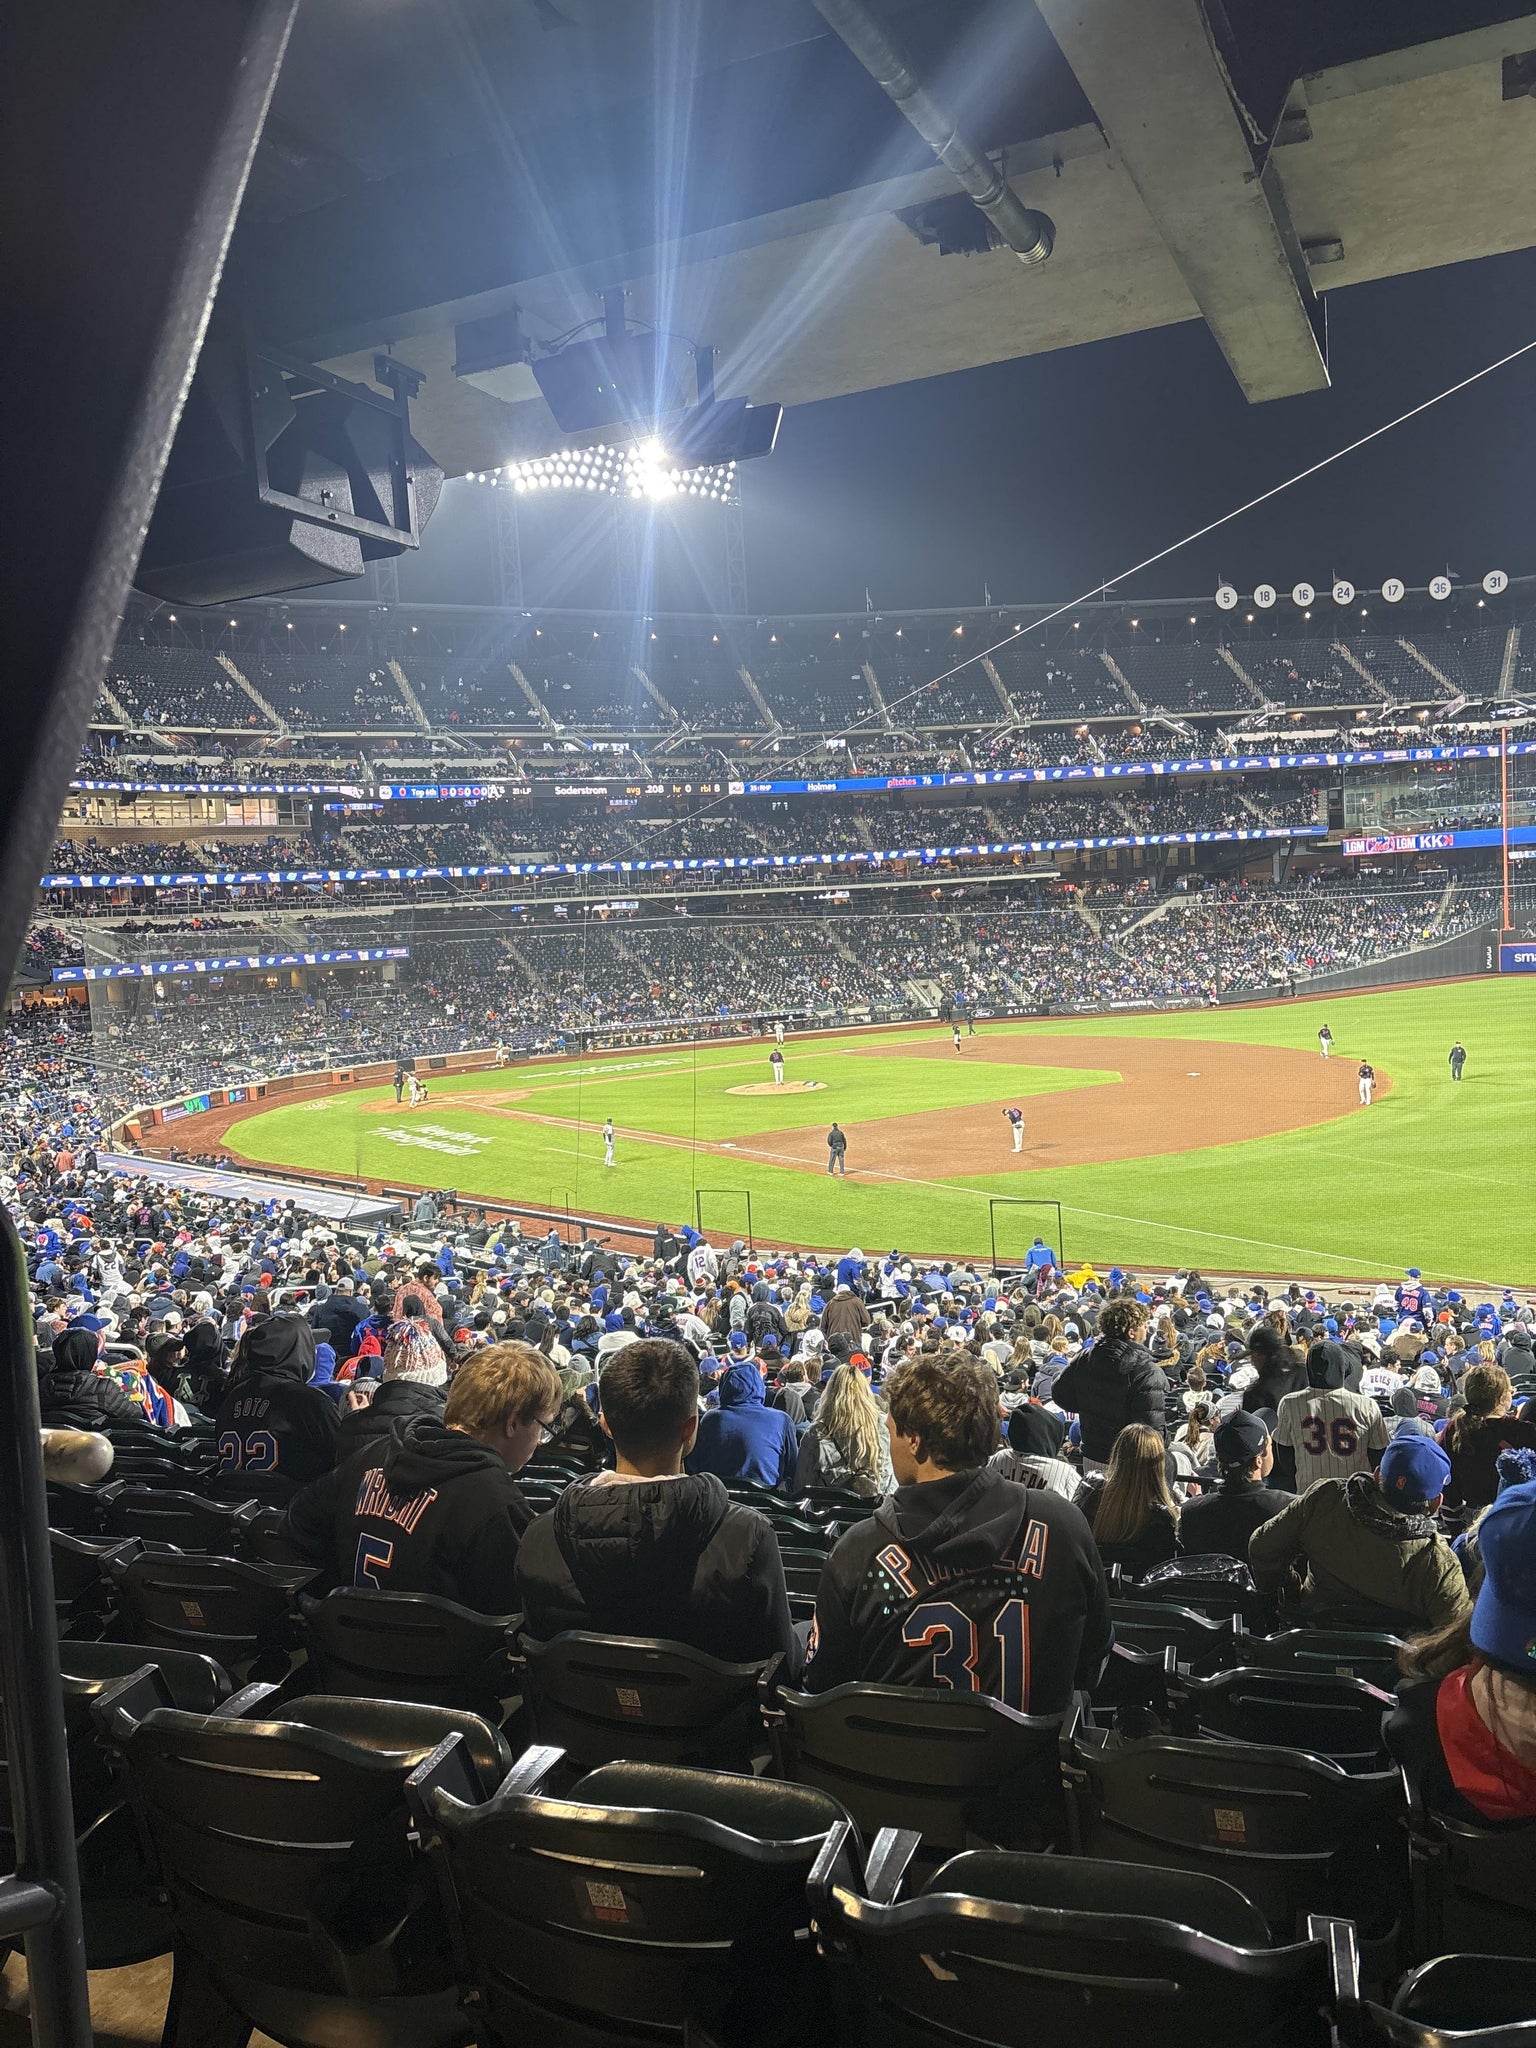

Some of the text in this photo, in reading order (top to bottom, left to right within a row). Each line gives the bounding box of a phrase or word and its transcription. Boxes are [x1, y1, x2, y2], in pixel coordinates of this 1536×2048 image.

[1433, 582, 1447, 594] 36
[1489, 576, 1501, 588] 31
[1259, 591, 1270, 602] 18
[1298, 589, 1309, 599] 16
[1337, 587, 1350, 598] 24
[1388, 585, 1398, 596] 17
[1223, 592, 1230, 603] 5
[807, 783, 837, 792] Holmes
[887, 776, 933, 788] pitches 76
[411, 788, 425, 799] Top
[554, 785, 608, 796] Soderstrom
[626, 786, 641, 796] avg
[645, 784, 664, 794] .208
[673, 784, 682, 794] hr
[684, 784, 692, 793] 0
[700, 785, 712, 793] rbi
[713, 783, 721, 794] 8
[1345, 840, 1366, 853] LGM
[1396, 837, 1416, 850] LGM
[103, 1261, 117, 1271] 22
[694, 1255, 706, 1269] 12
[1400, 1296, 1419, 1312] 48
[1369, 1375, 1391, 1386] REYES
[233, 1397, 270, 1419] SOTO
[1300, 1415, 1358, 1457] 36
[218, 1430, 279, 1472] 22
[354, 1531, 395, 1591] 5
[901, 1598, 1030, 1715] 31
